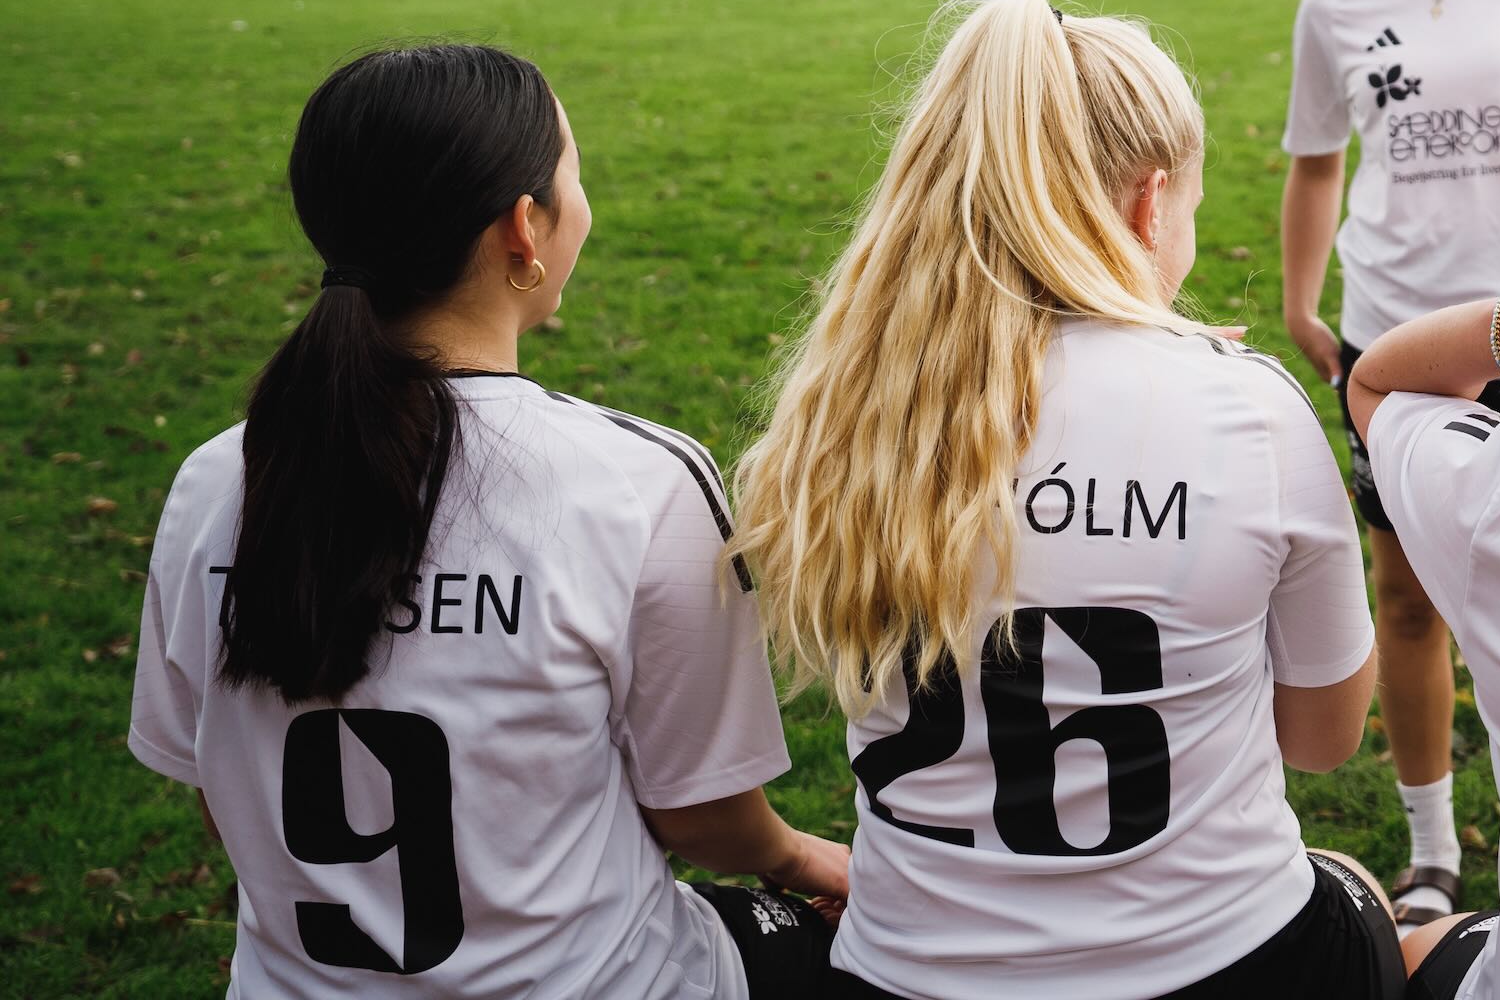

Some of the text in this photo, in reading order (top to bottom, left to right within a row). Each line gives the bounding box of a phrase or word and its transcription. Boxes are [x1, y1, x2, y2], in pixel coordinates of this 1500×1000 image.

[993, 462, 1188, 540] ÓLM
[282, 708, 464, 974] 9
[852, 606, 1171, 856] 26
